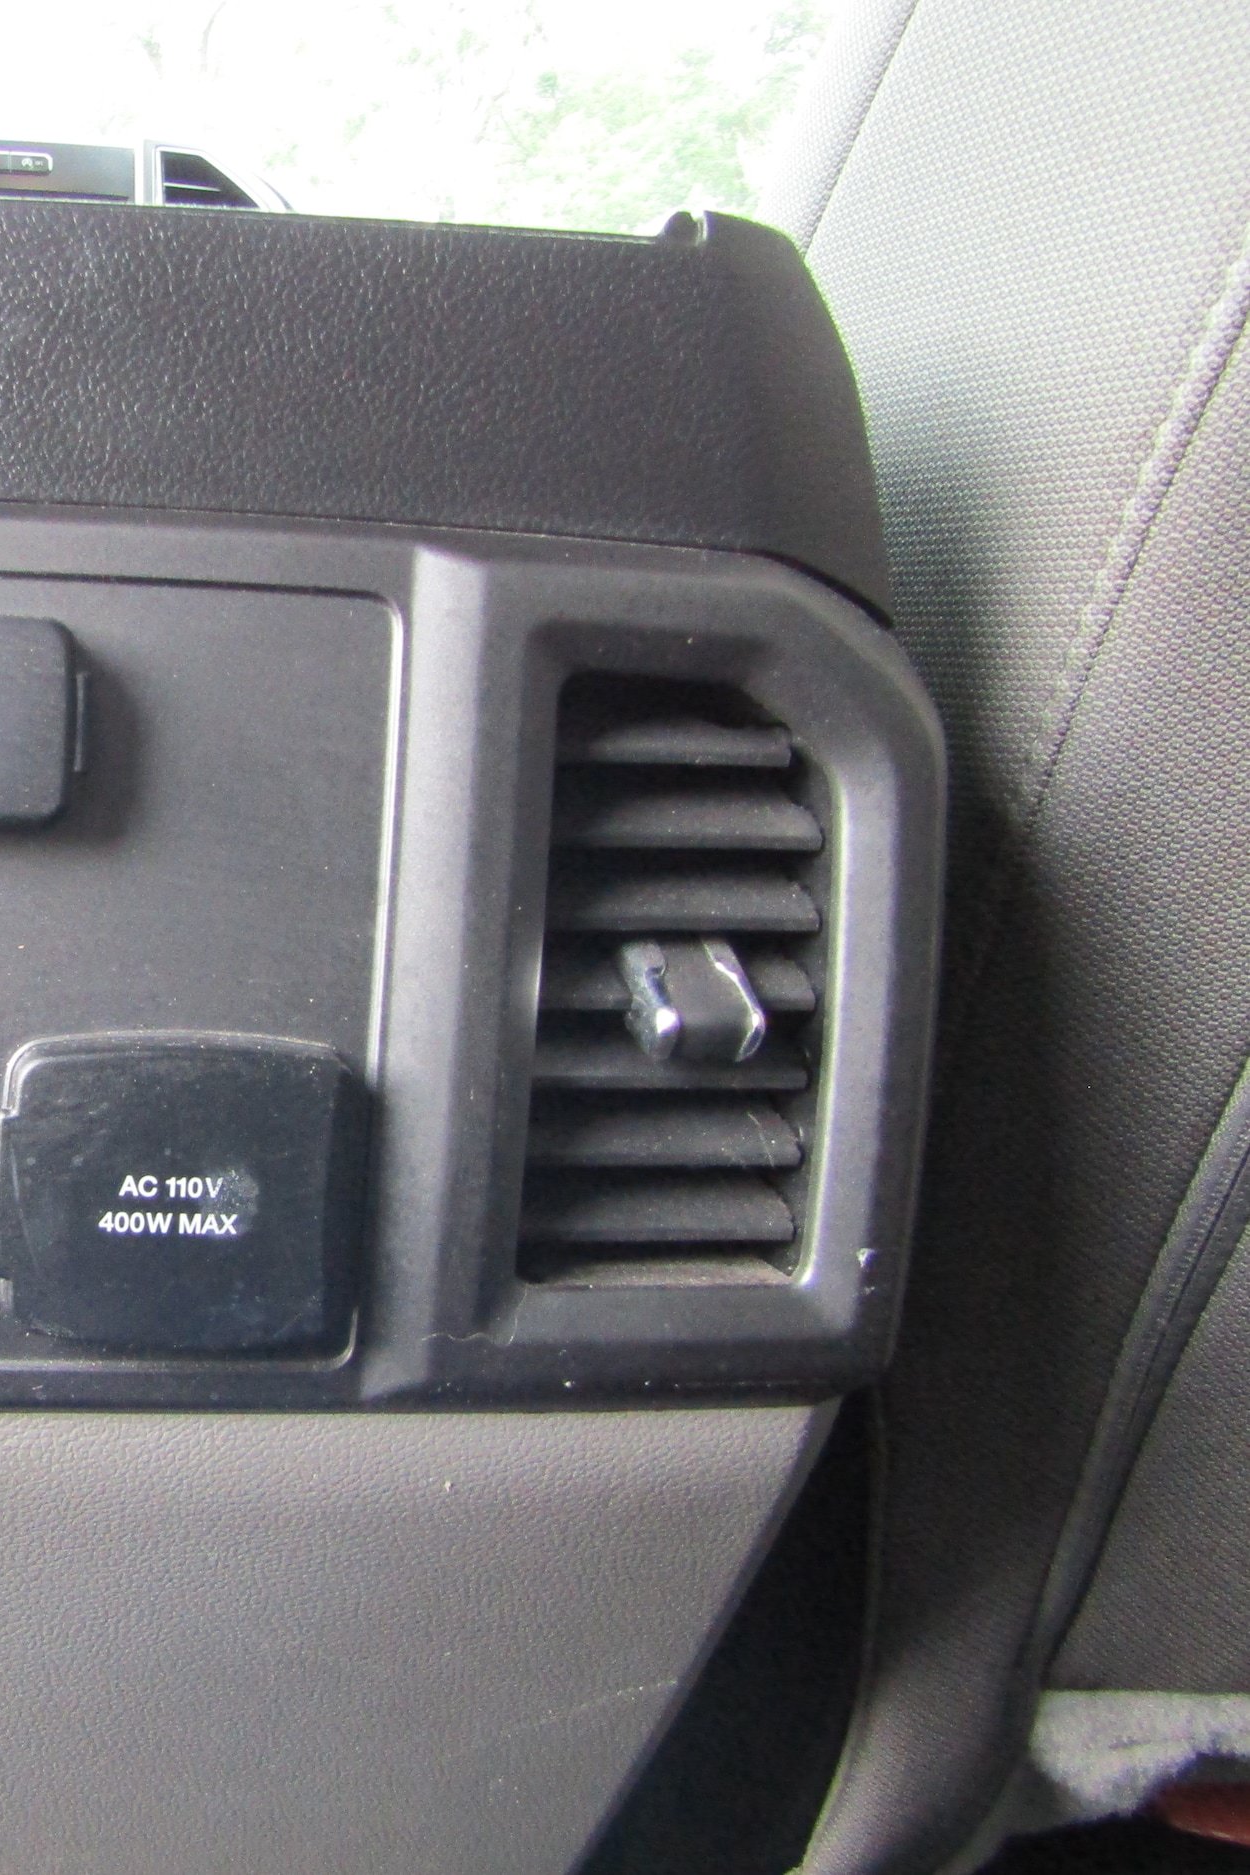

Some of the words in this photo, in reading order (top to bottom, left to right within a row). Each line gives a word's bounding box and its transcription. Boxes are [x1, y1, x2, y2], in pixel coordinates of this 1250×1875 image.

[119, 1175, 158, 1197] AC
[165, 1176, 224, 1198] 110V
[98, 1211, 173, 1234] 400W
[178, 1213, 238, 1235] MAX
